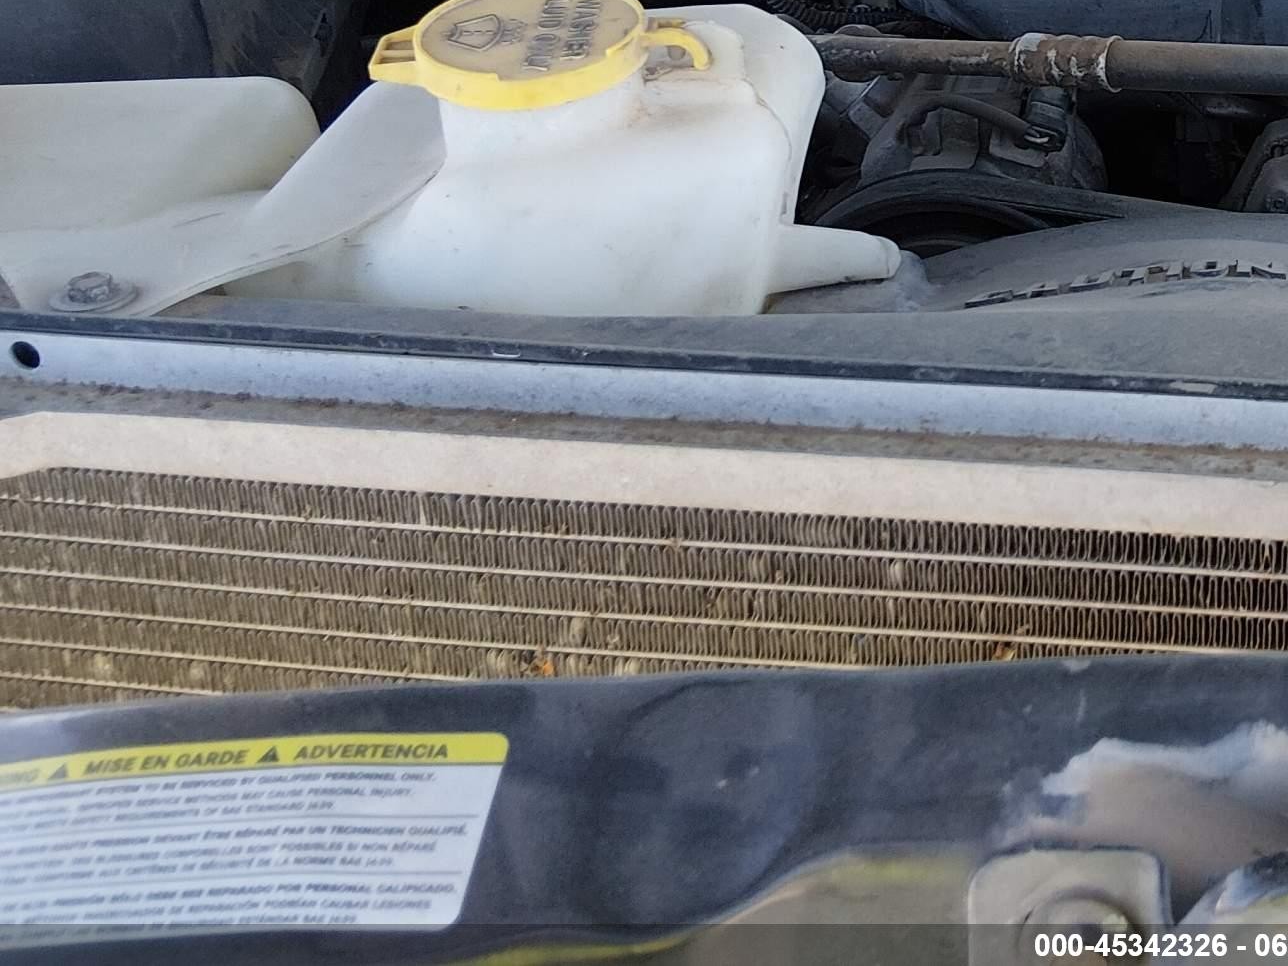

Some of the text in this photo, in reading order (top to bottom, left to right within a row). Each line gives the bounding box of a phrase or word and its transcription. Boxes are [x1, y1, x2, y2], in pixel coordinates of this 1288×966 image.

[521, 33, 560, 71] ONLY
[963, 260, 1287, 309] CAUTION
[83, 743, 448, 776] MISE EN GARDE ADVERTENCIA
[308, 787, 367, 797] PERSONAL
[325, 772, 397, 782] PERSONNEL
